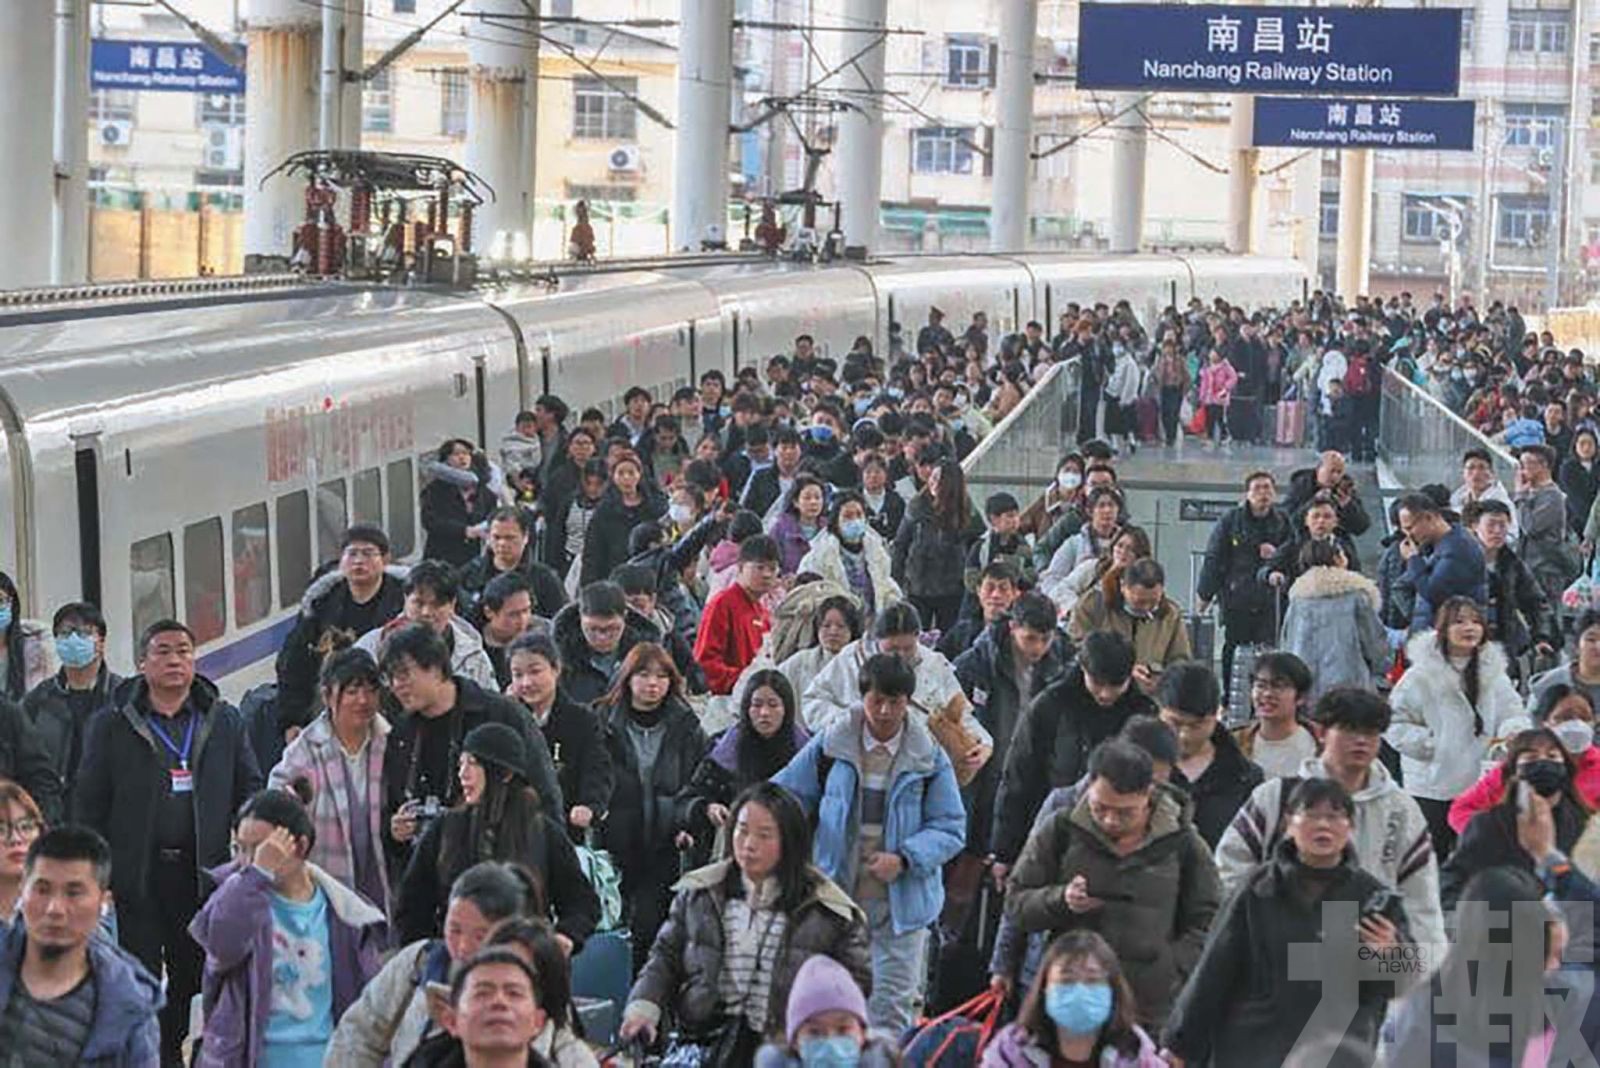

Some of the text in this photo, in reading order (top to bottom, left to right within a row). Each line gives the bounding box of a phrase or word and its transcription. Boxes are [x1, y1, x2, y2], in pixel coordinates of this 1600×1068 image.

[1207, 15, 1333, 53] 南昌站
[129, 46, 204, 69] 南昌站
[1143, 60, 1393, 85] Nanchang Railway Station
[1328, 102, 1402, 126] 南昌站
[1290, 128, 1437, 145] Nanchang Railway Station
